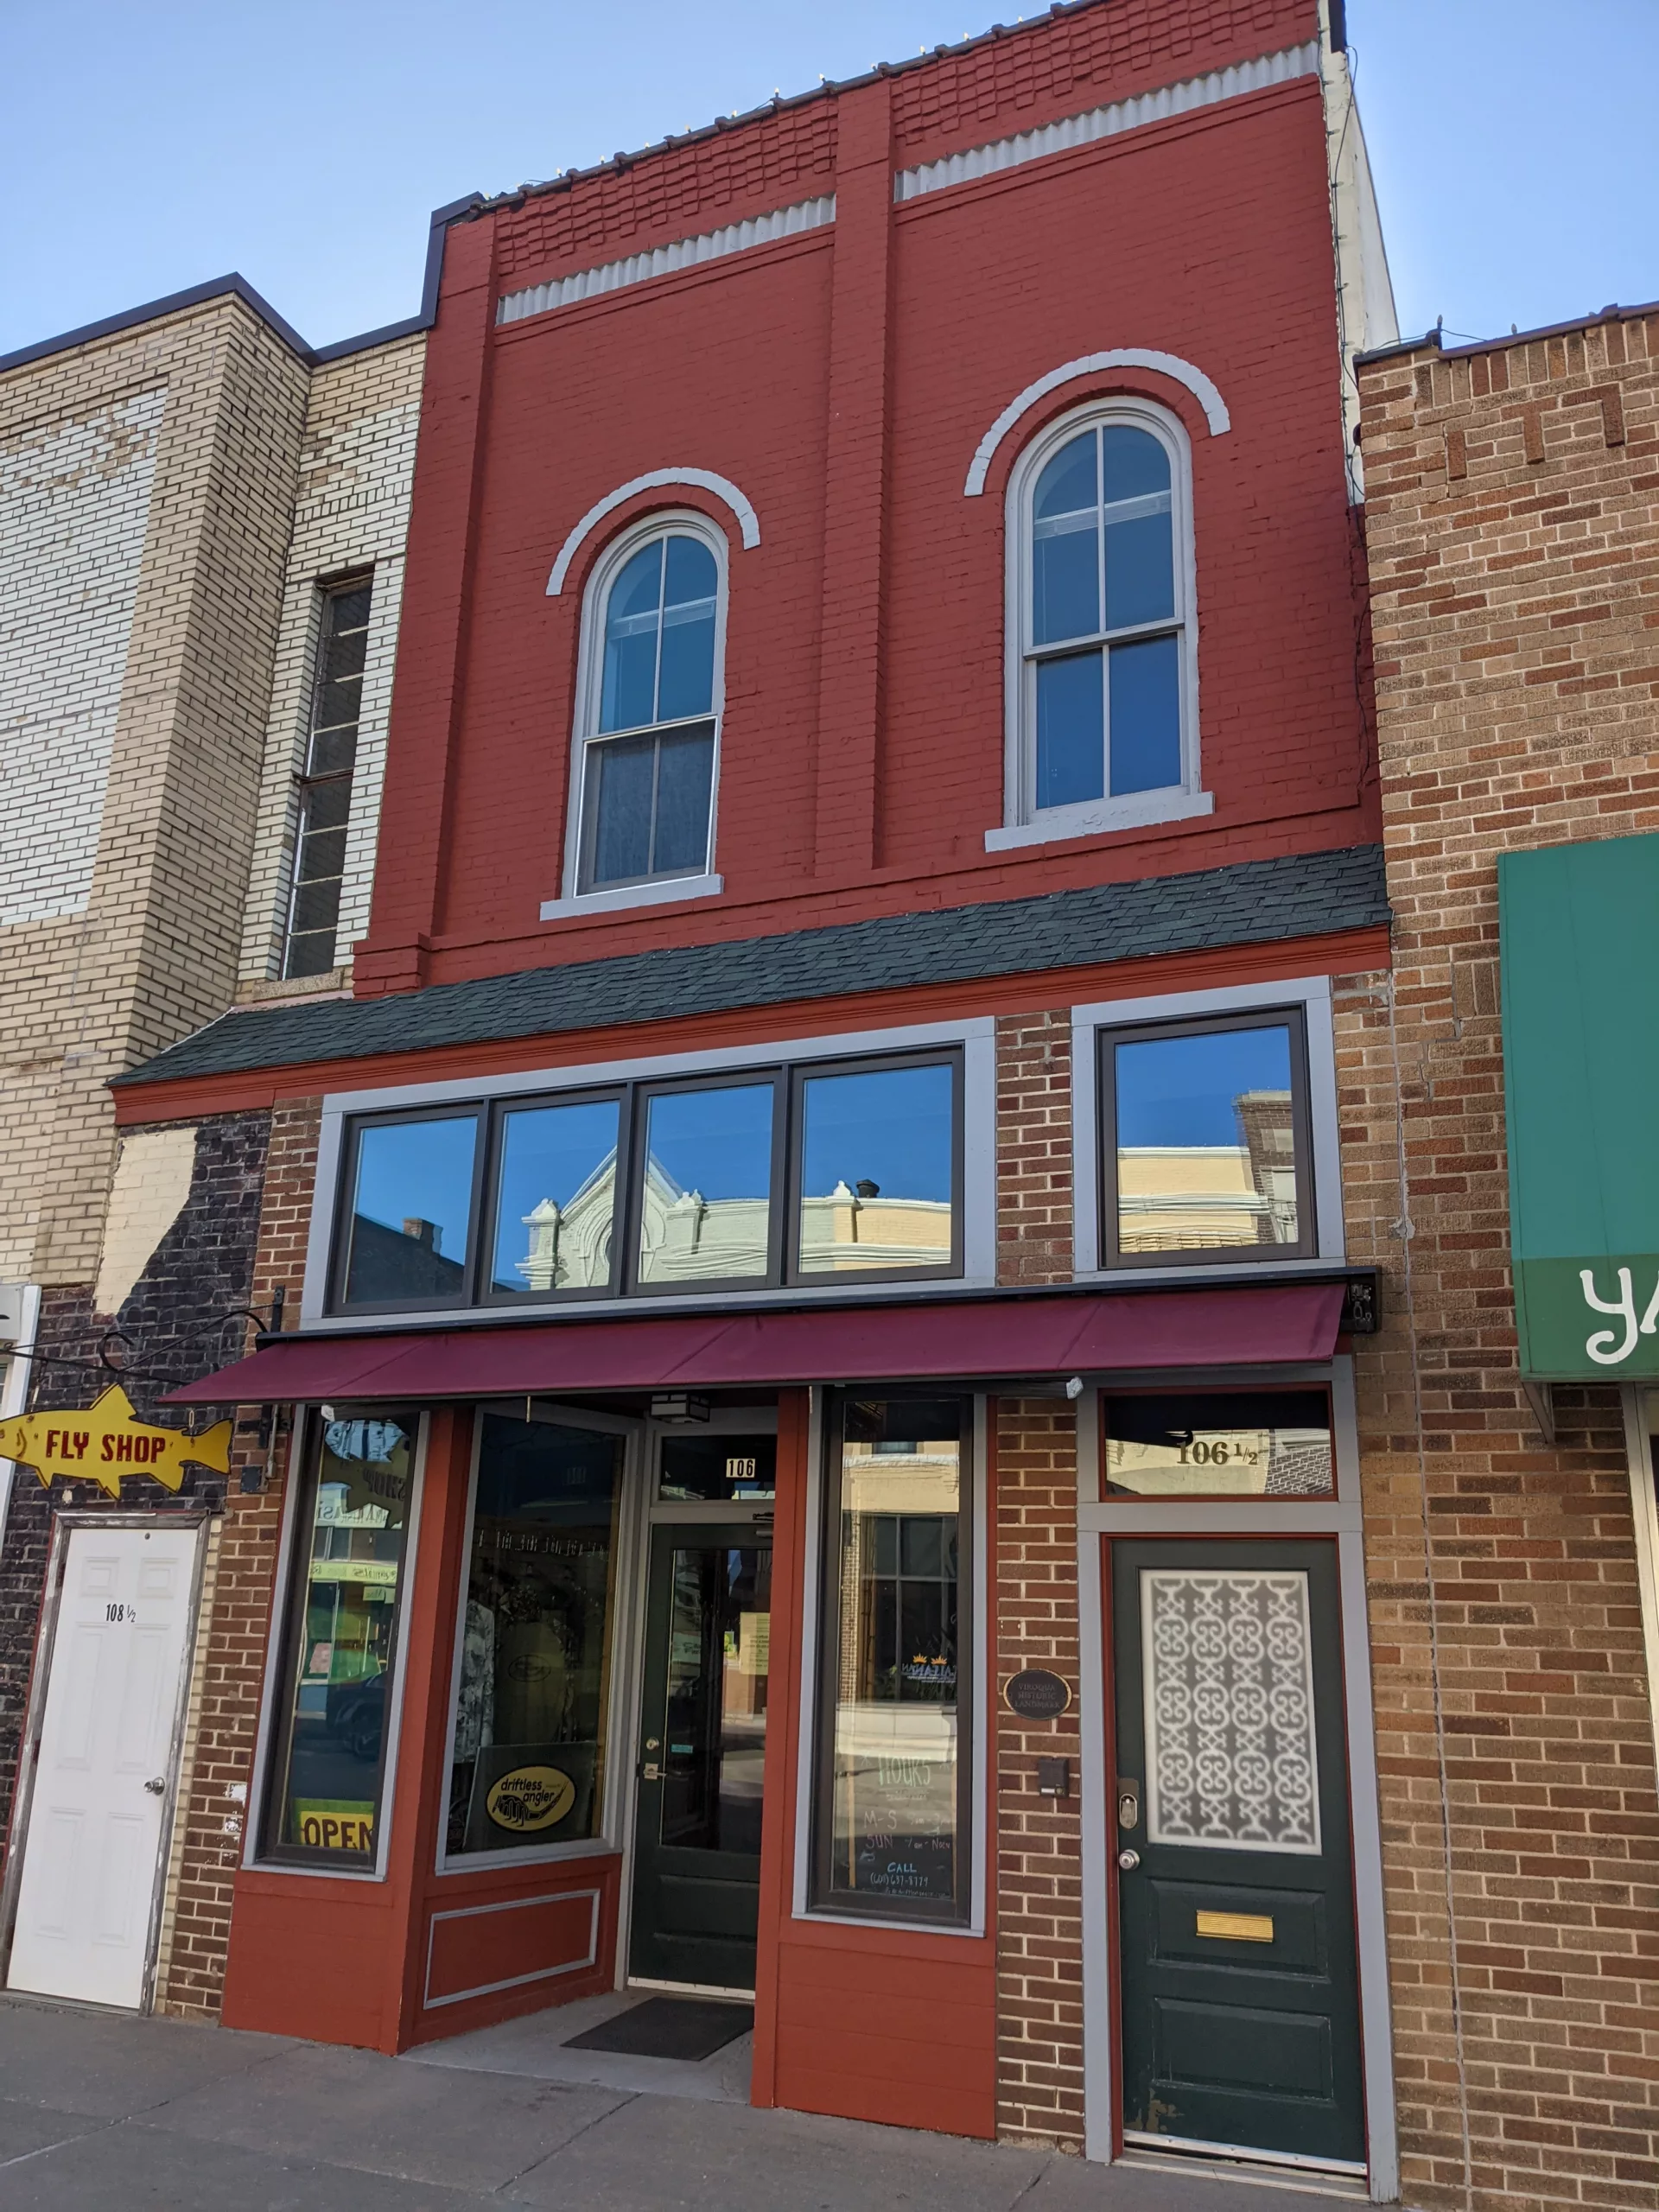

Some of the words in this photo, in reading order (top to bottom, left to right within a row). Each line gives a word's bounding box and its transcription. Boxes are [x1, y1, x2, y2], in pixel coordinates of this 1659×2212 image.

[46, 1430, 89, 1459] FLY
[101, 1434, 166, 1463] SHOP
[1177, 1441, 1229, 1465] 106
[728, 1459, 753, 1477] 106
[106, 1604, 124, 1622] 108
[1018, 1691, 1057, 1700] HISTORIC
[1019, 1683, 1056, 1692] VIROQUA
[1014, 1700, 1060, 1708] LANDMARK
[501, 1778, 543, 1791] driftless
[523, 1789, 555, 1807] angler
[304, 1817, 372, 1850] OPEN
[887, 1862, 917, 1872] CALL
